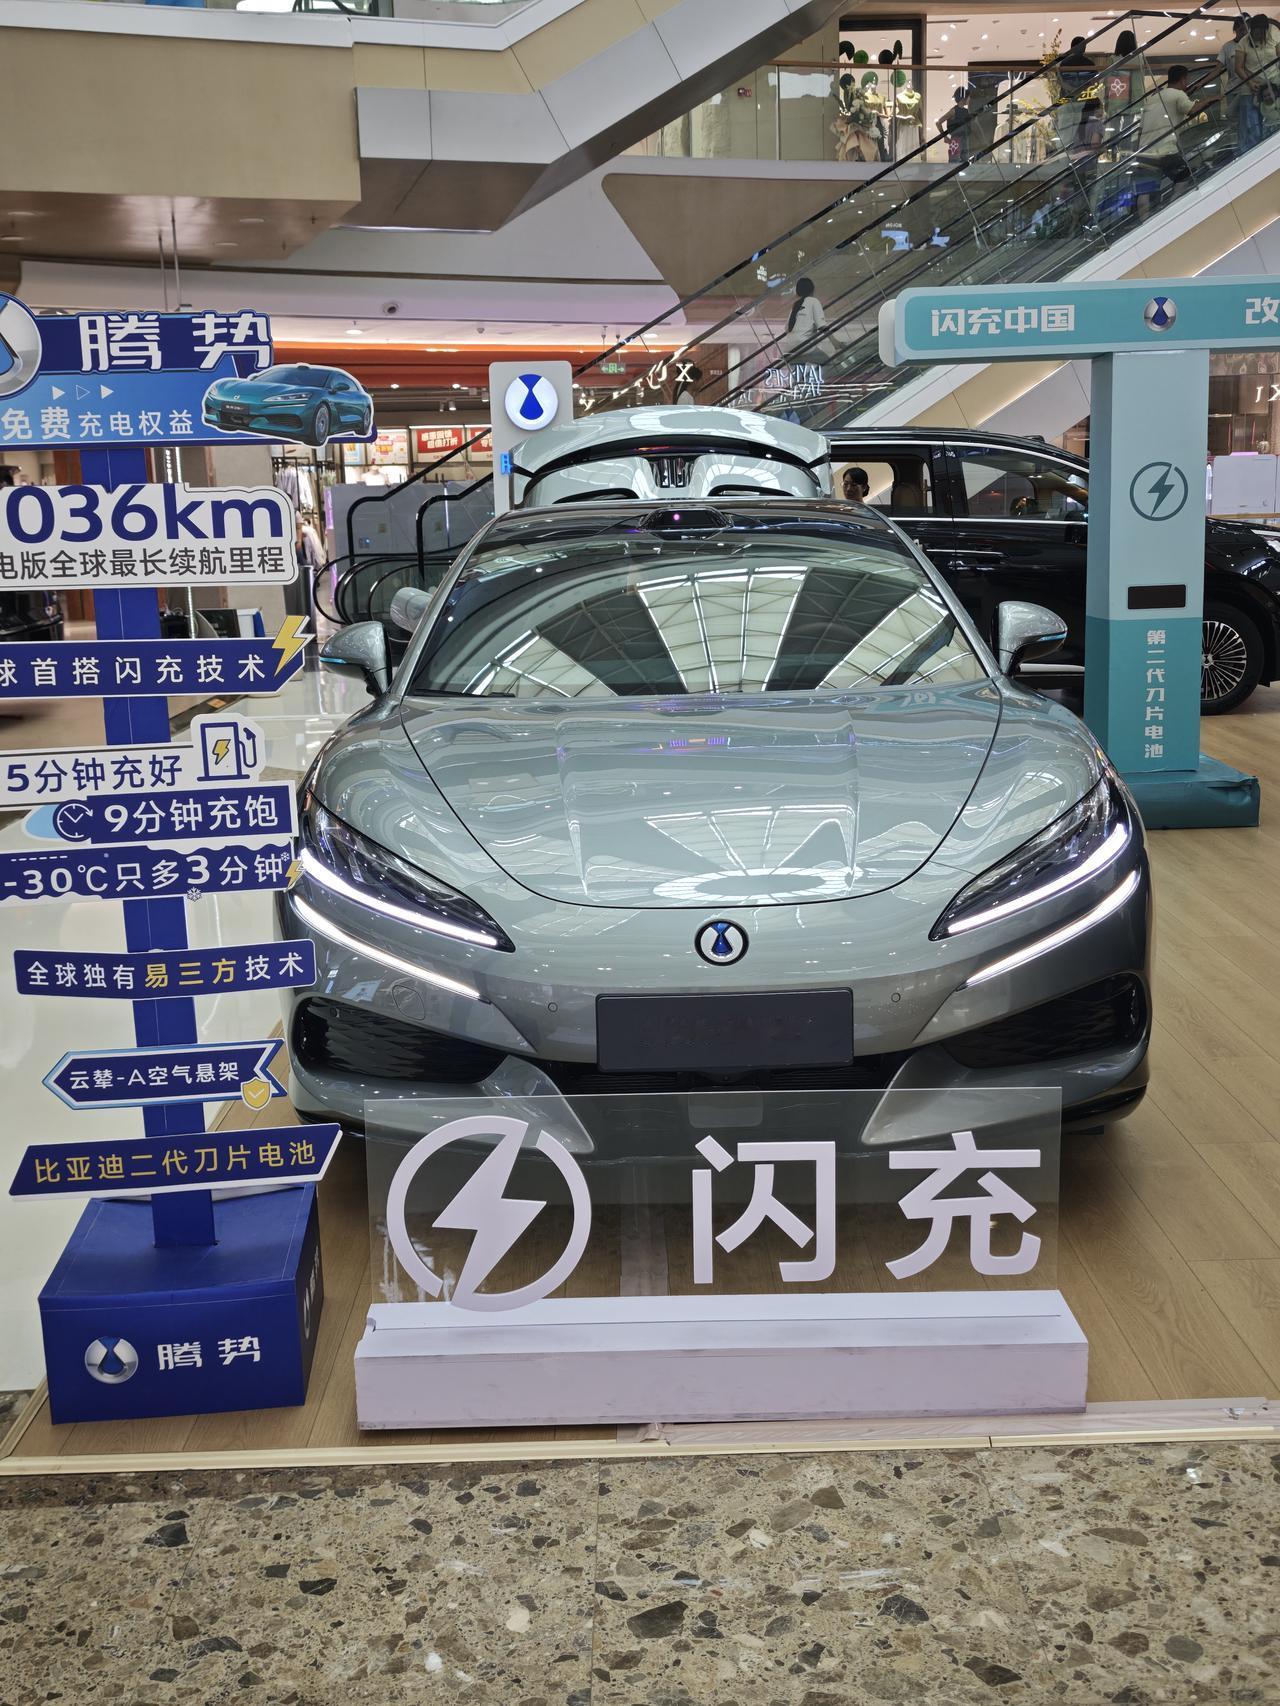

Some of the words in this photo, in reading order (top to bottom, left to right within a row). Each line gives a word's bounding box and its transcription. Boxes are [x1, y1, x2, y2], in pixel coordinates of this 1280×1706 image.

[931, 304, 1075, 336] 闪充中国
[1245, 297, 1280, 324] 改
[79, 313, 272, 371] 腾势
[1, 406, 194, 439] 免费充电权益
[6, 484, 284, 543] 036km
[0, 547, 285, 580] 电版全球最长续航里程
[1144, 630, 1166, 758] 第二代刀片电池
[6, 754, 183, 794] 5分钟充好
[104, 794, 278, 835] 9分钟充饱
[27, 951, 304, 990] 全球独有易三方技术
[69, 1061, 240, 1090] 云辇-A空气悬架
[34, 1140, 316, 1184] 比亚迪二代刀片电池
[691, 1131, 1042, 1284] 闪充
[157, 1336, 261, 1370] 腾势
